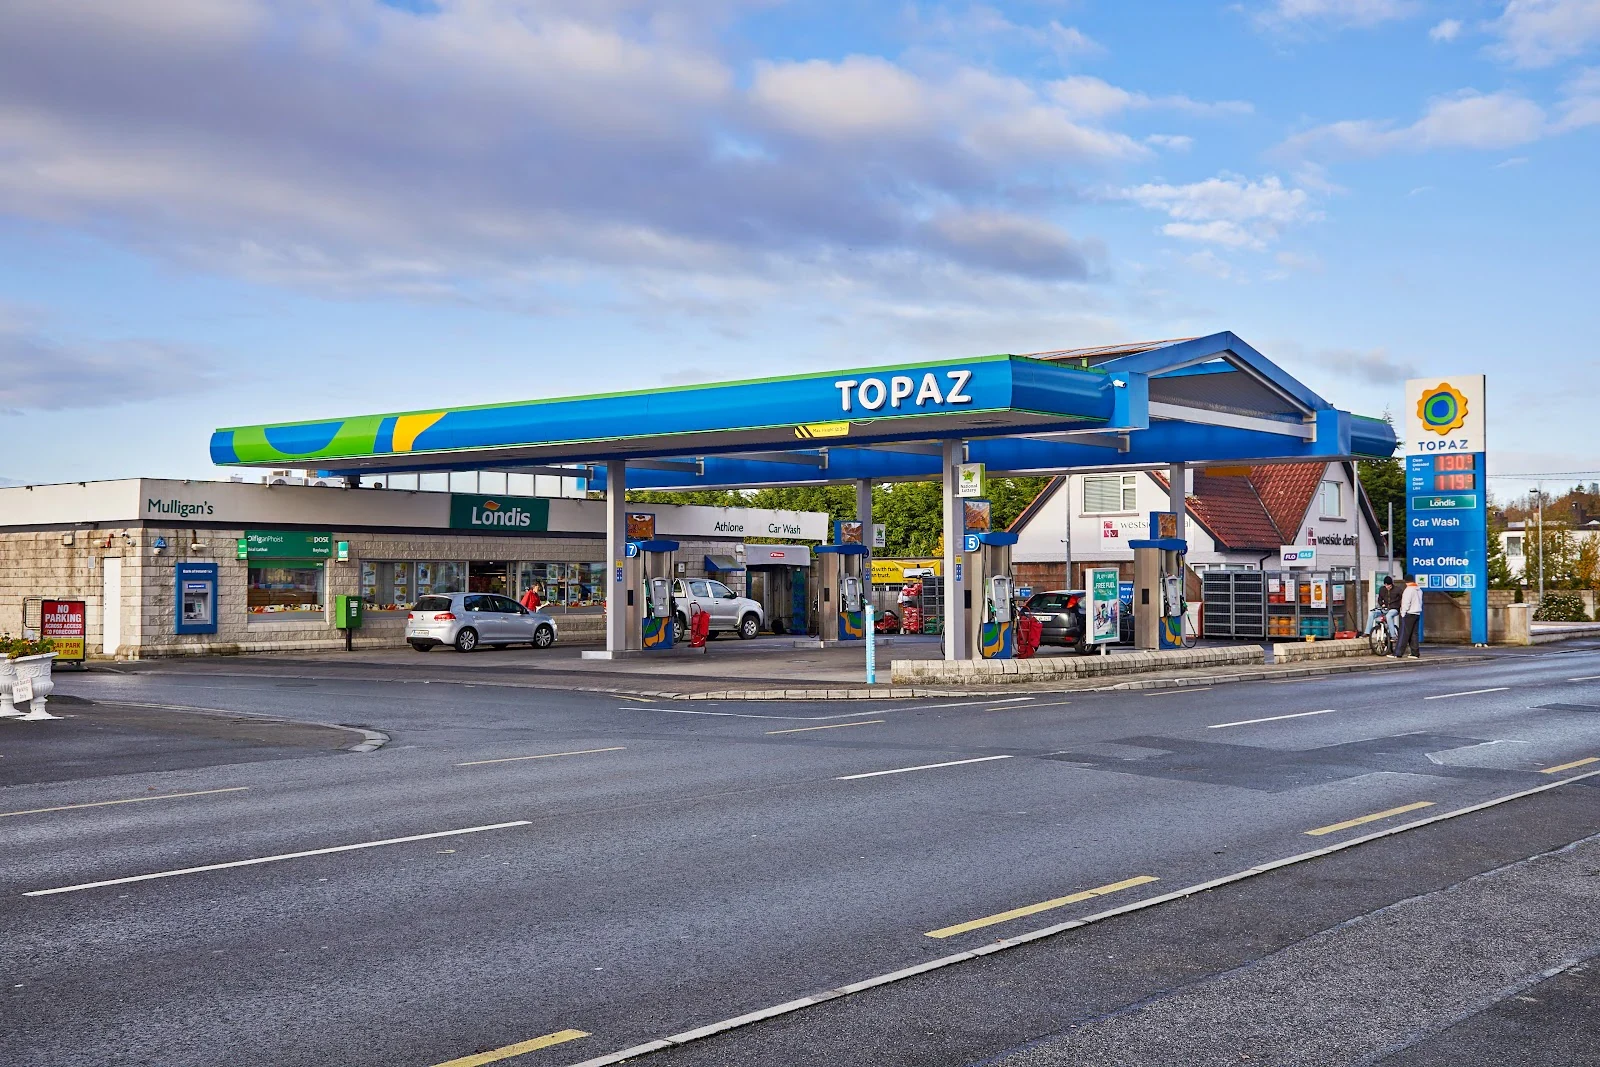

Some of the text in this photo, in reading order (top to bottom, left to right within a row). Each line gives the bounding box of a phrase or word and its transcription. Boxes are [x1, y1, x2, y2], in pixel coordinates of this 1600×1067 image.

[834, 370, 972, 412] TOPAZ
[1417, 439, 1469, 451] TOPAZ
[1429, 498, 1456, 507] Londis
[147, 498, 214, 518] Mulligan's
[471, 506, 531, 527] Londis
[1120, 518, 1150, 529] westsi
[1412, 517, 1460, 527] Car Wash
[713, 521, 801, 535] Athlone Car Wash
[314, 536, 329, 544] post
[968, 537, 976, 549] 5
[1317, 533, 1342, 546] westside
[1412, 537, 1434, 547] ATM
[628, 545, 635, 555] 7
[1412, 556, 1469, 566] Post Office
[1095, 581, 1116, 589] FREE FUEL
[57, 604, 69, 614] NO
[44, 613, 82, 623] PARKING
